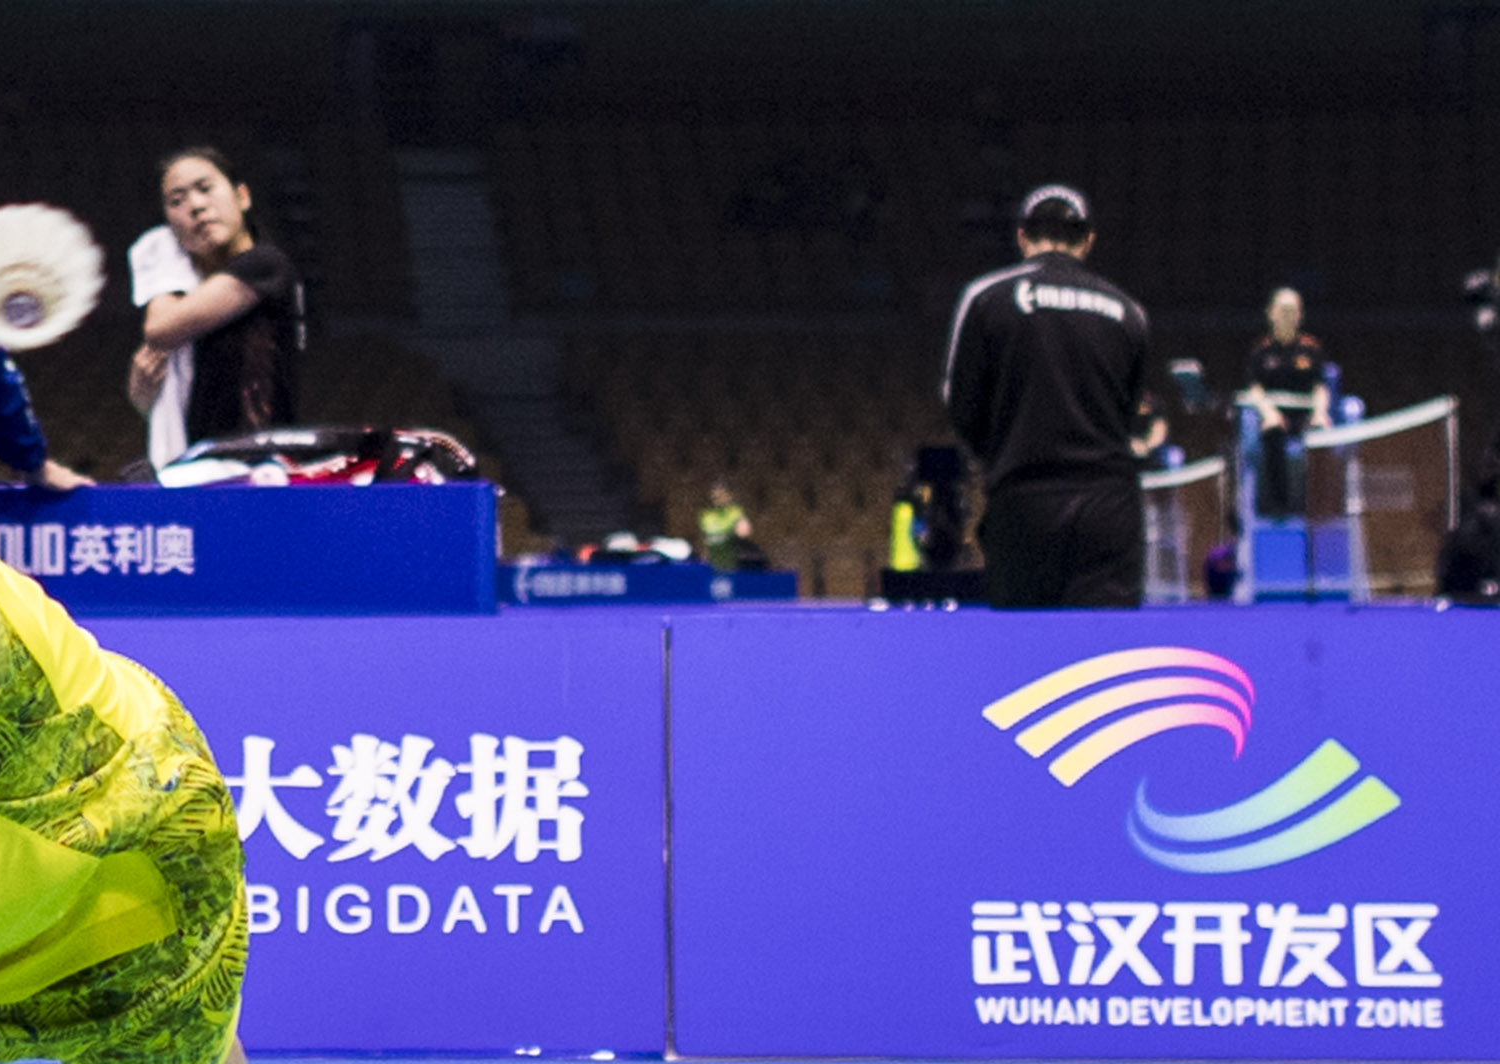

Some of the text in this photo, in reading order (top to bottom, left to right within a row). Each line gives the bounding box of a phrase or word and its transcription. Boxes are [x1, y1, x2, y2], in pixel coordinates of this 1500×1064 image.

[69, 523, 195, 576] 英利奥
[222, 733, 590, 862] 大数据
[245, 884, 584, 934] BIGDATA
[971, 901, 1443, 987] 武汉开发区
[975, 997, 1444, 1028] WUHAN DEVELOPMENT ZONE
